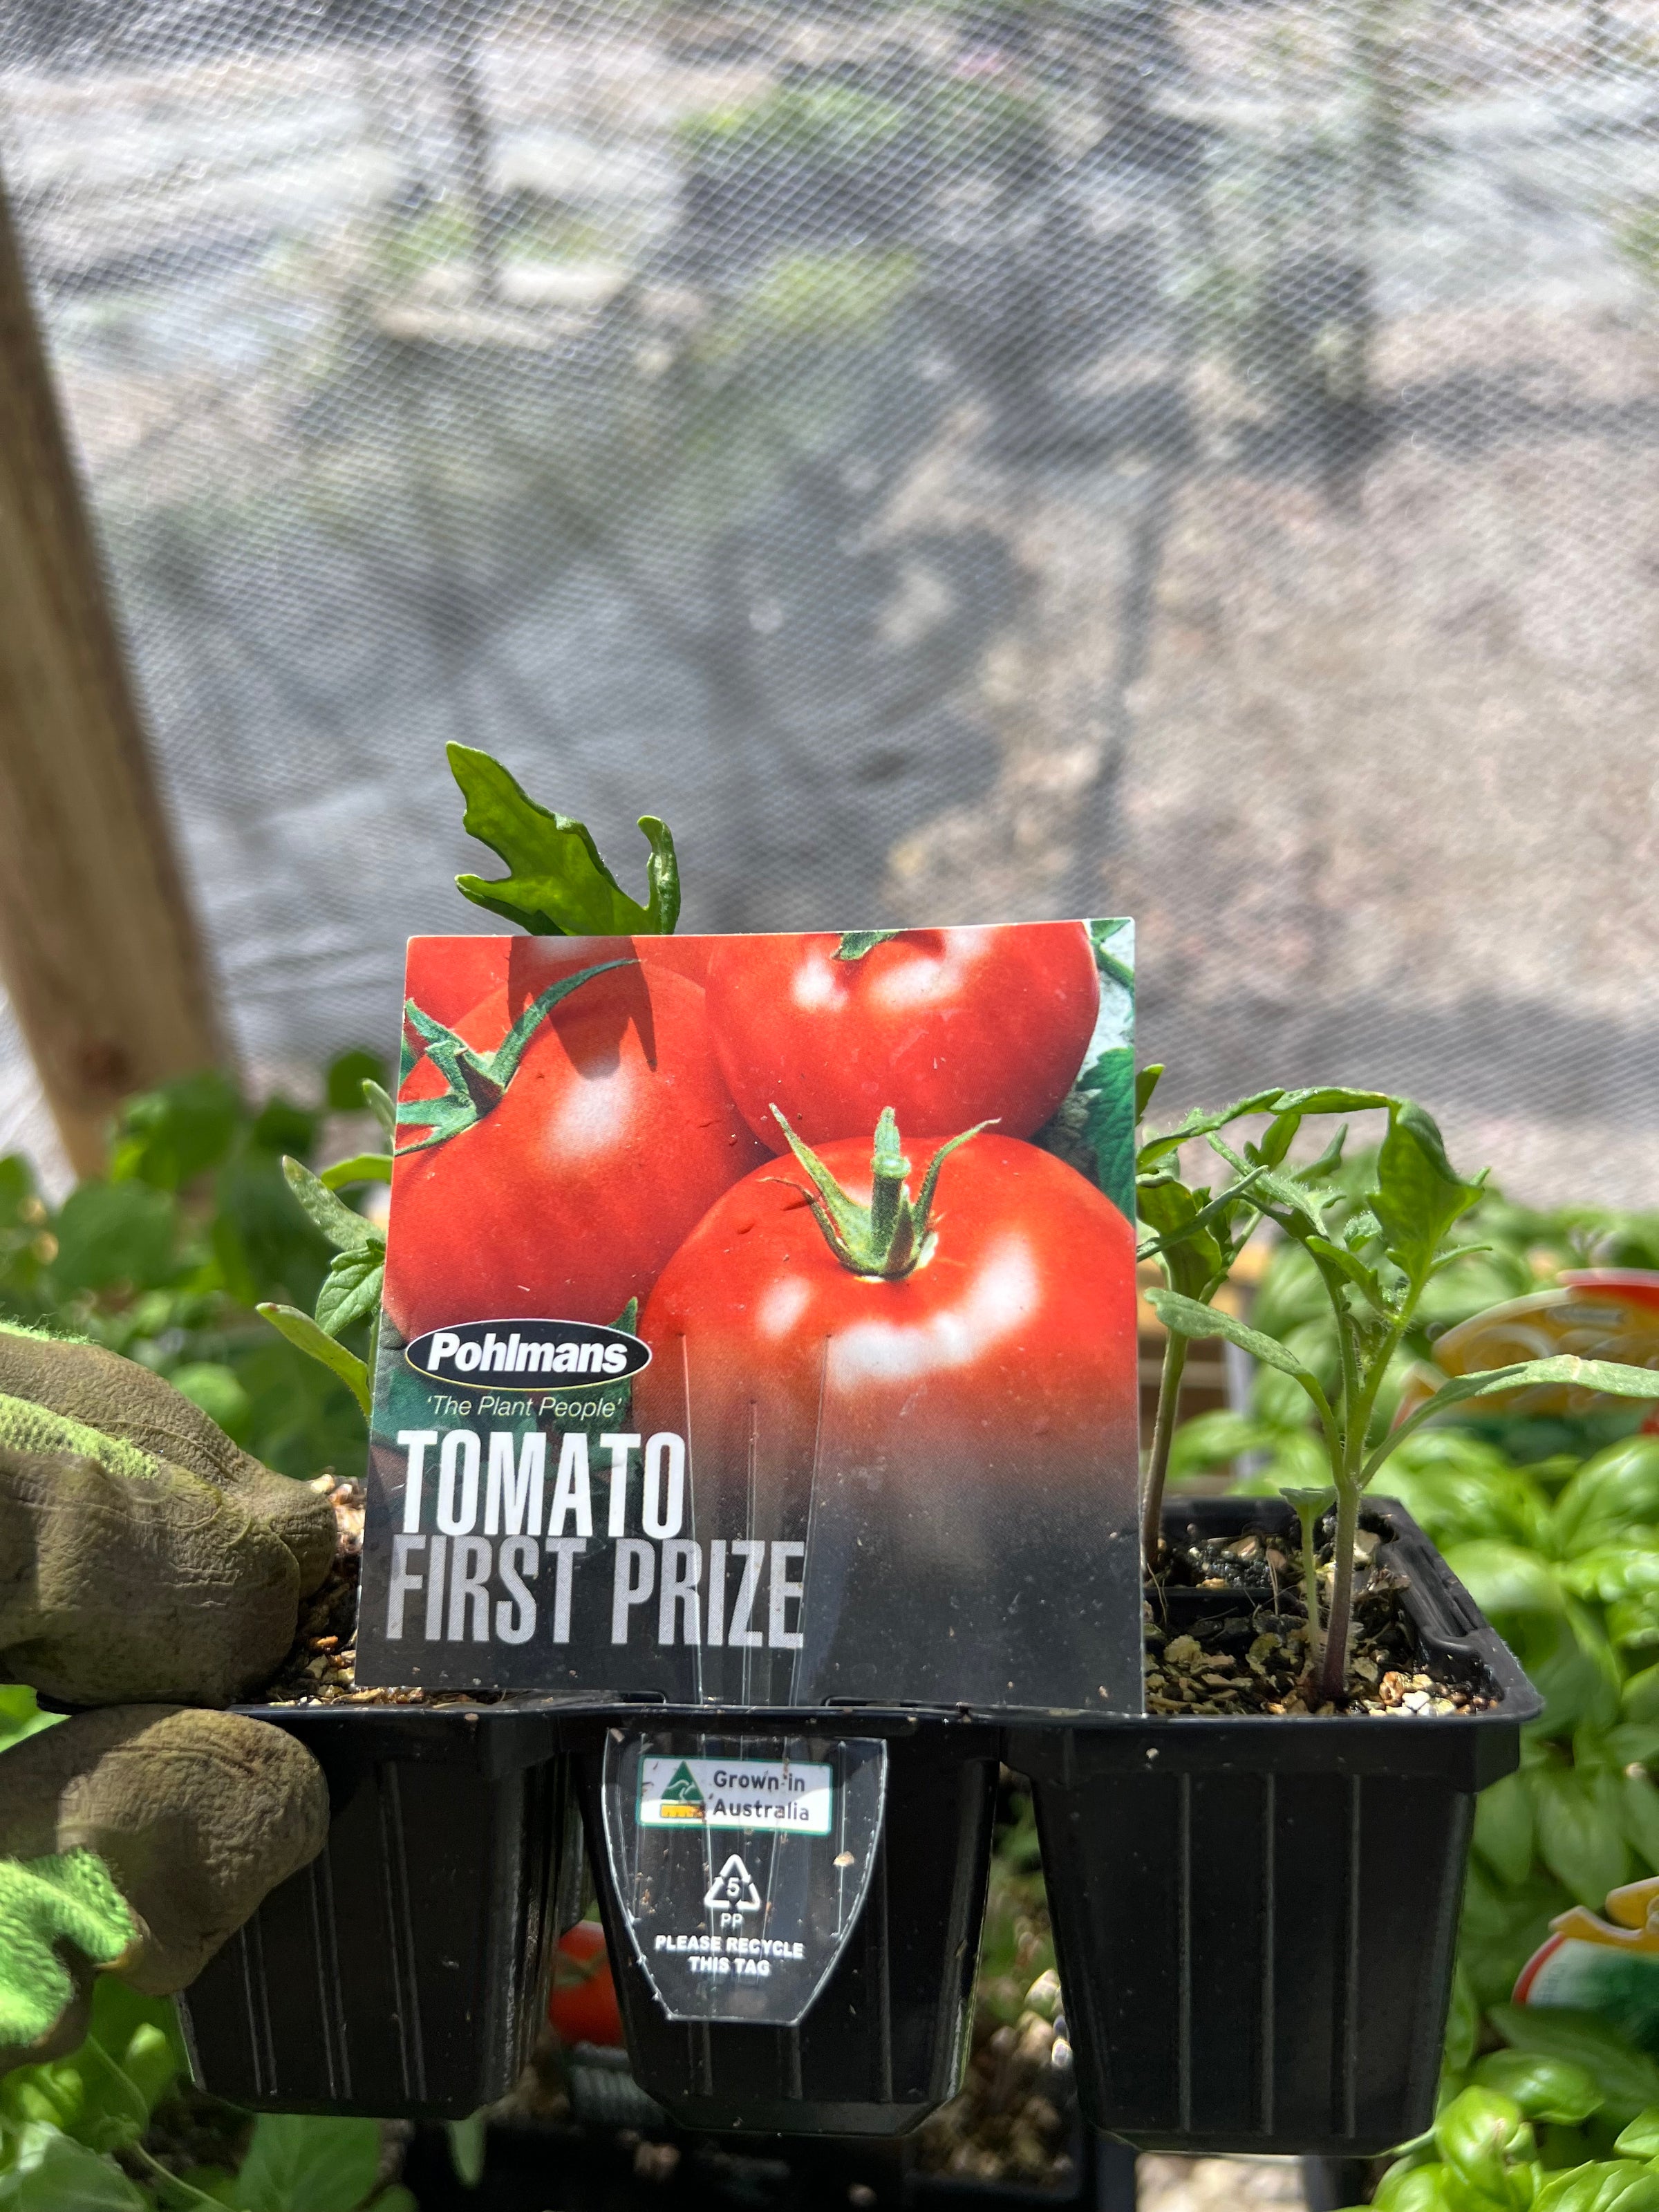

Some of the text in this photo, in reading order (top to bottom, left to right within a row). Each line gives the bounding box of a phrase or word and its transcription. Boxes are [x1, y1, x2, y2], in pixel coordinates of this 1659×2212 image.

[427, 1333, 628, 1374] Pohlmans
[477, 1396, 534, 1417] Plant
[397, 1430, 686, 1539] TOMATO
[386, 1534, 805, 1648] FIRST PRIZE
[713, 1770, 805, 1792] Grown in
[713, 1798, 809, 1821] Australia
[727, 1877, 740, 1897] 5
[720, 1913, 744, 1928] PP
[655, 1935, 804, 1958] PLEASE RECYCLE
[689, 1956, 771, 1976] THIS TAG
